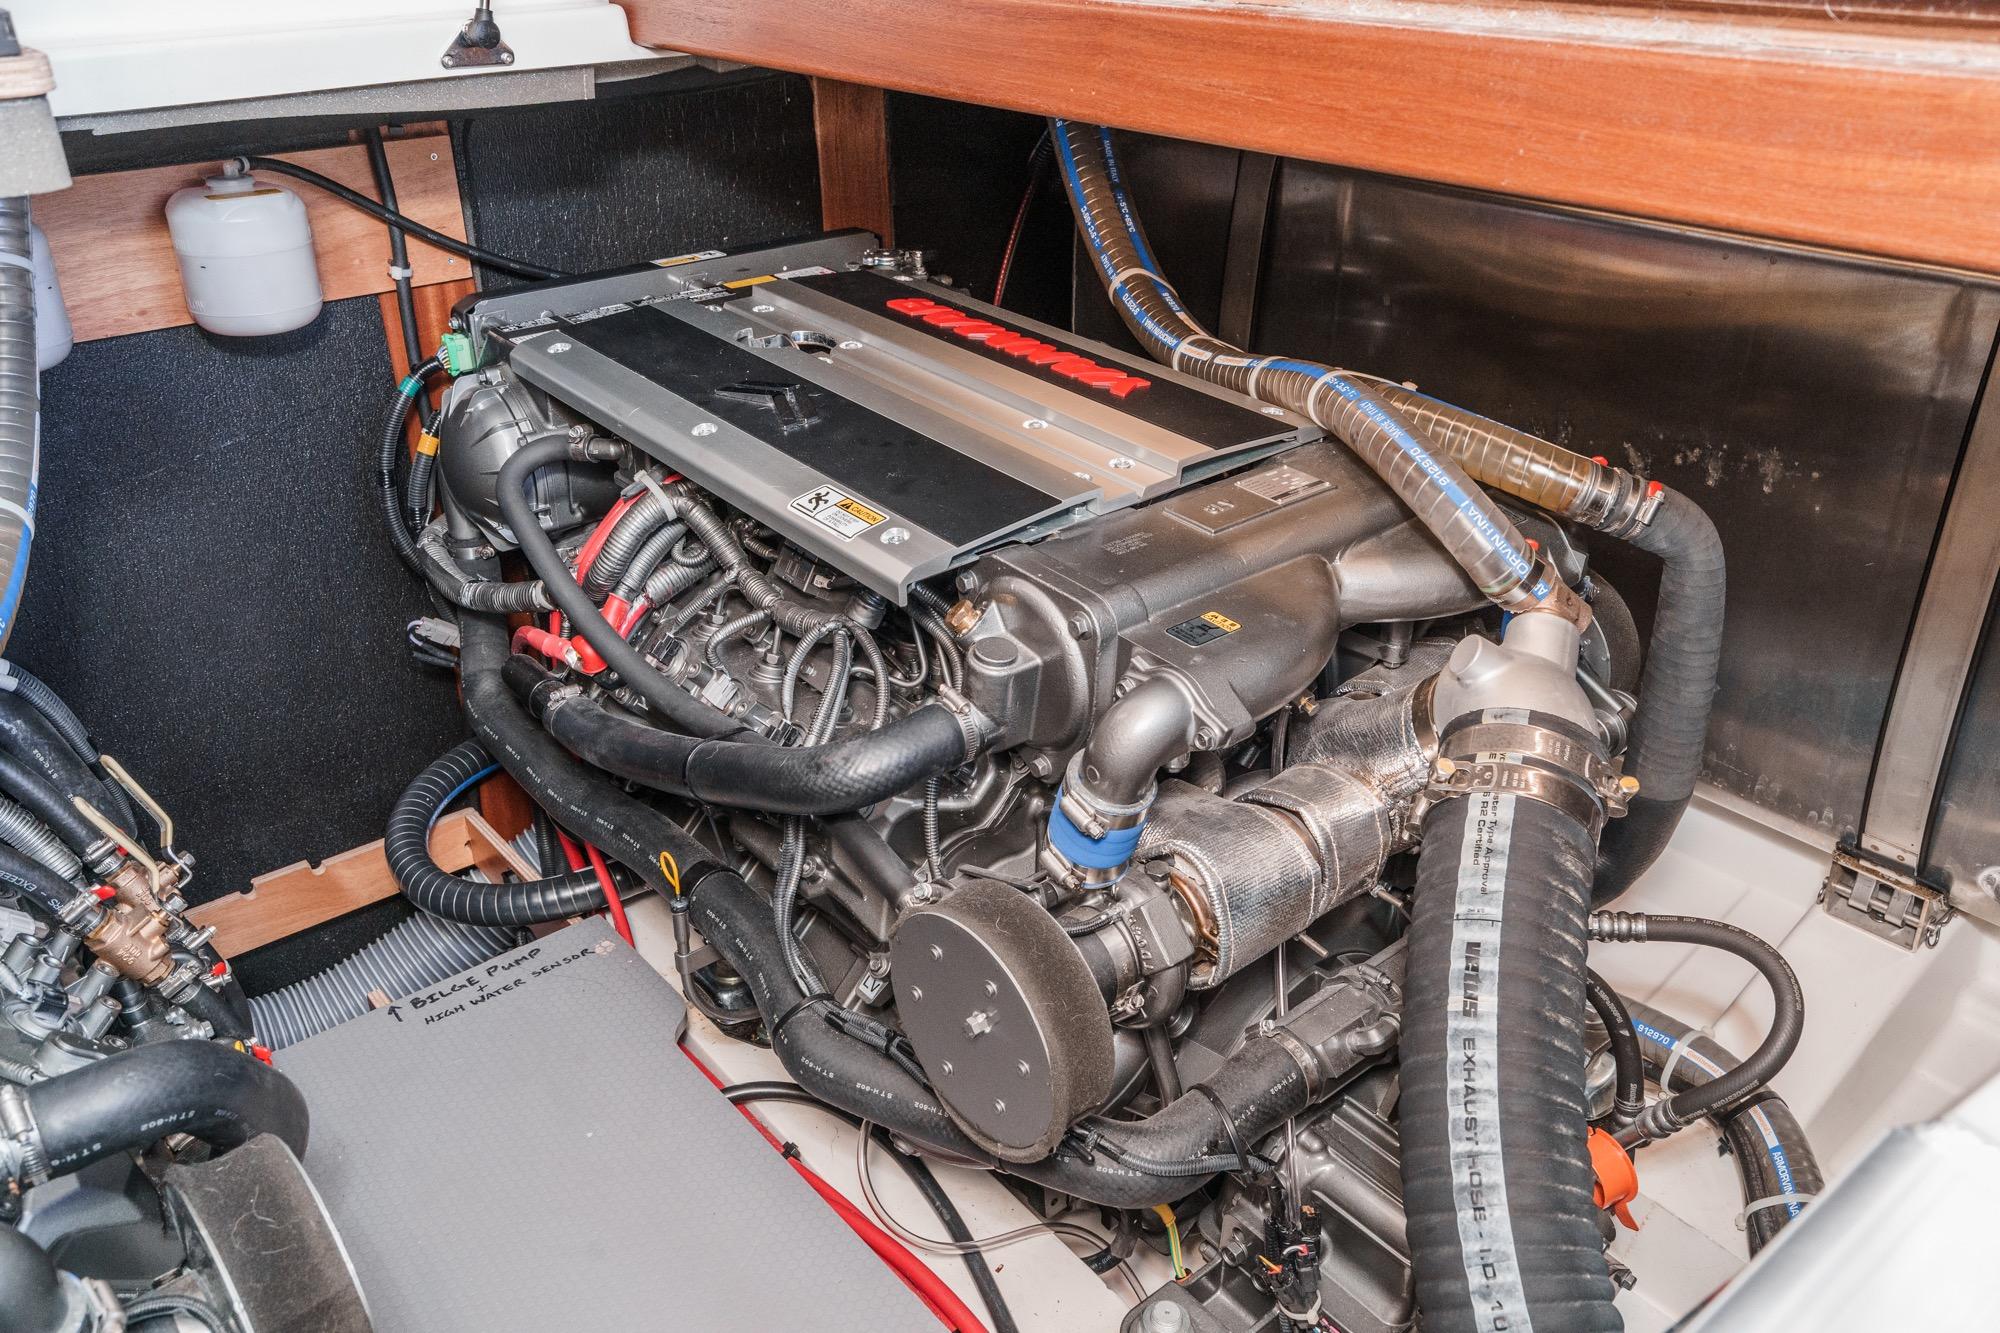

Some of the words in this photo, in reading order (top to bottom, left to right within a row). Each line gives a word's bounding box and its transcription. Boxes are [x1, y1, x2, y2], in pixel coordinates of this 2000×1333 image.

[1409, 447, 1450, 486] 912970
[851, 506, 880, 522] CAUTION
[1480, 800, 1489, 817] R2
[1473, 819, 1486, 866] Certified
[1487, 820, 1498, 844] Type
[1481, 847, 1494, 895] Approval
[410, 976, 480, 1010] BILGE
[486, 947, 541, 977] PUMP
[425, 1004, 466, 1025] HIGH
[469, 978, 526, 1006] WATER
[531, 948, 596, 978] SENSOR
[863, 975, 881, 992] LV
[1637, 1024, 1670, 1045] 912970
[1463, 1037, 1480, 1147] EXHAUST
[1467, 1154, 1487, 1222] HOSE
[1772, 1151, 1794, 1195] ARMORVIN
